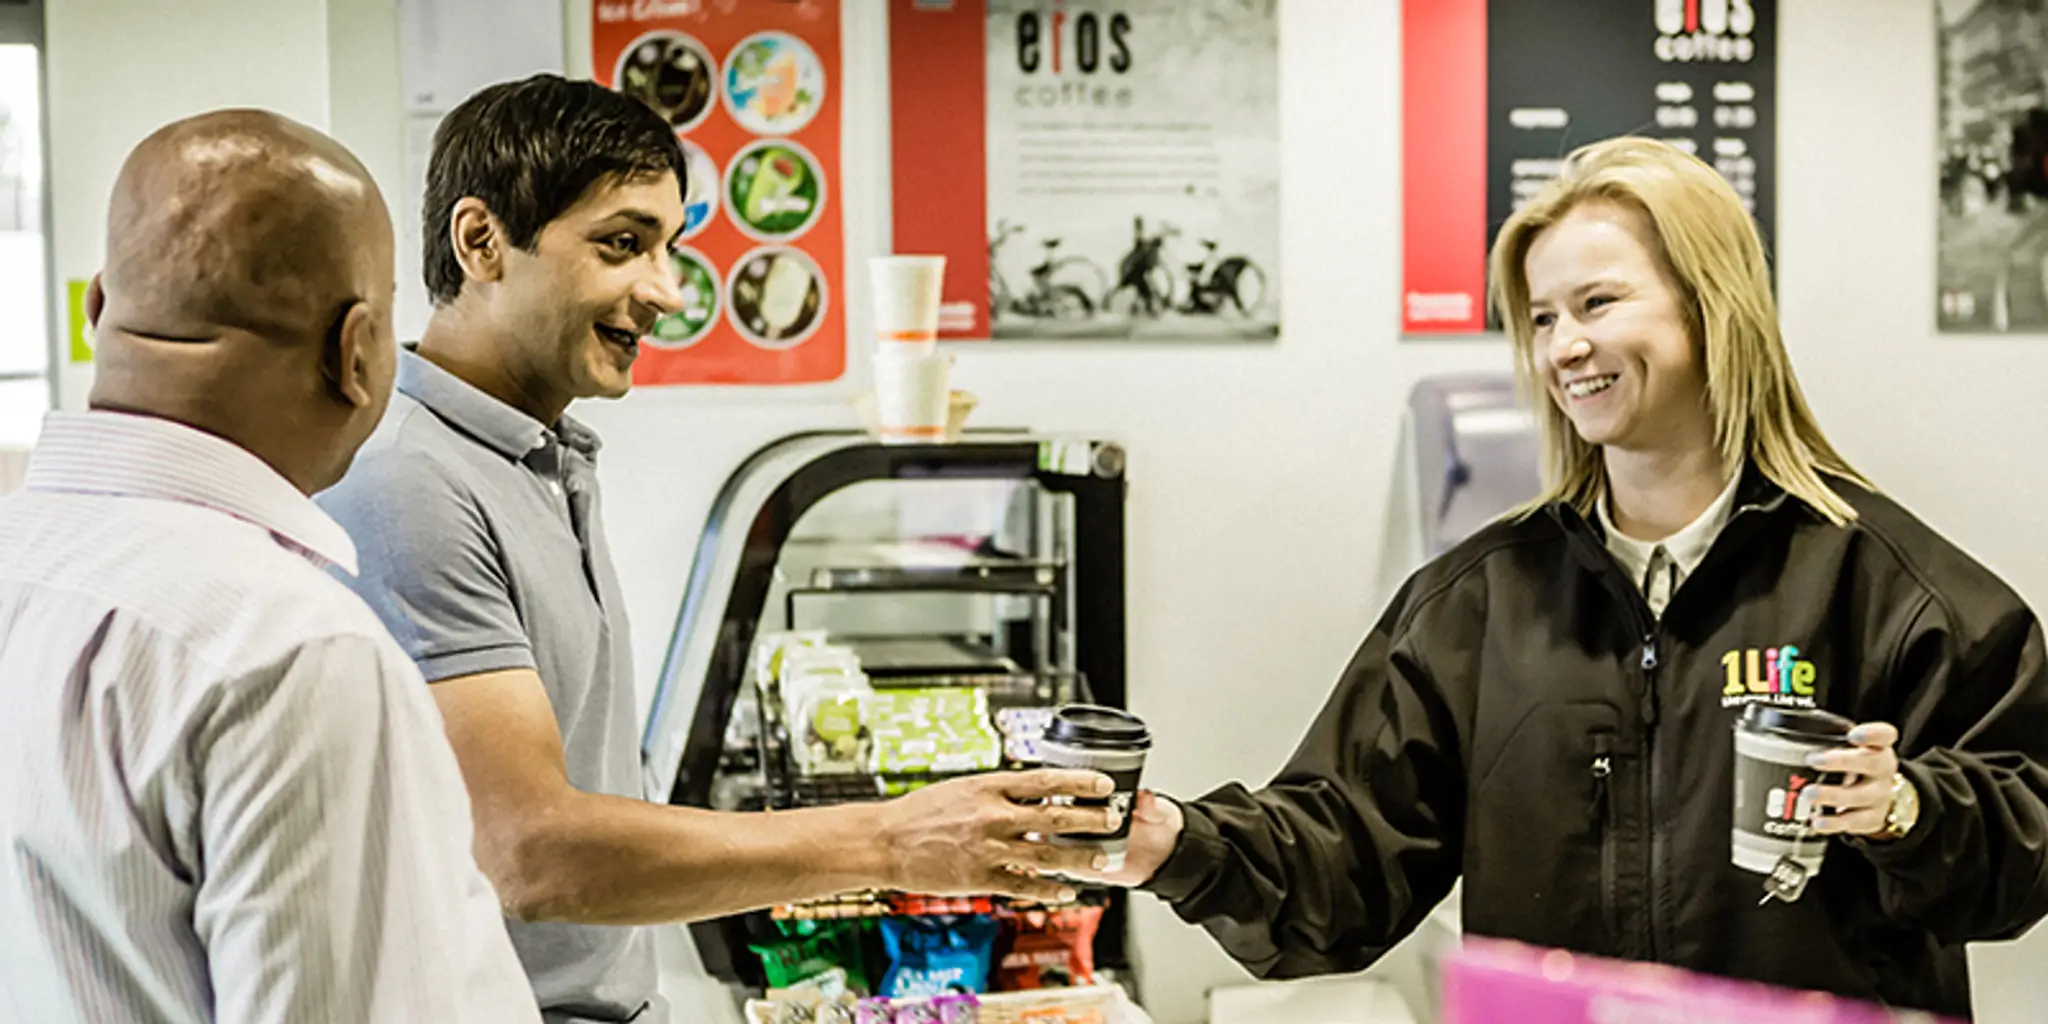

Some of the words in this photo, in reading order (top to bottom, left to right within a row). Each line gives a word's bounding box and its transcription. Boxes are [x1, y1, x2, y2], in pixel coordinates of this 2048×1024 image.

[1016, 10, 1132, 75] eros
[1655, 31, 1754, 61] coffee
[1015, 82, 1132, 108] coffee
[1721, 645, 1816, 695] 1Life
